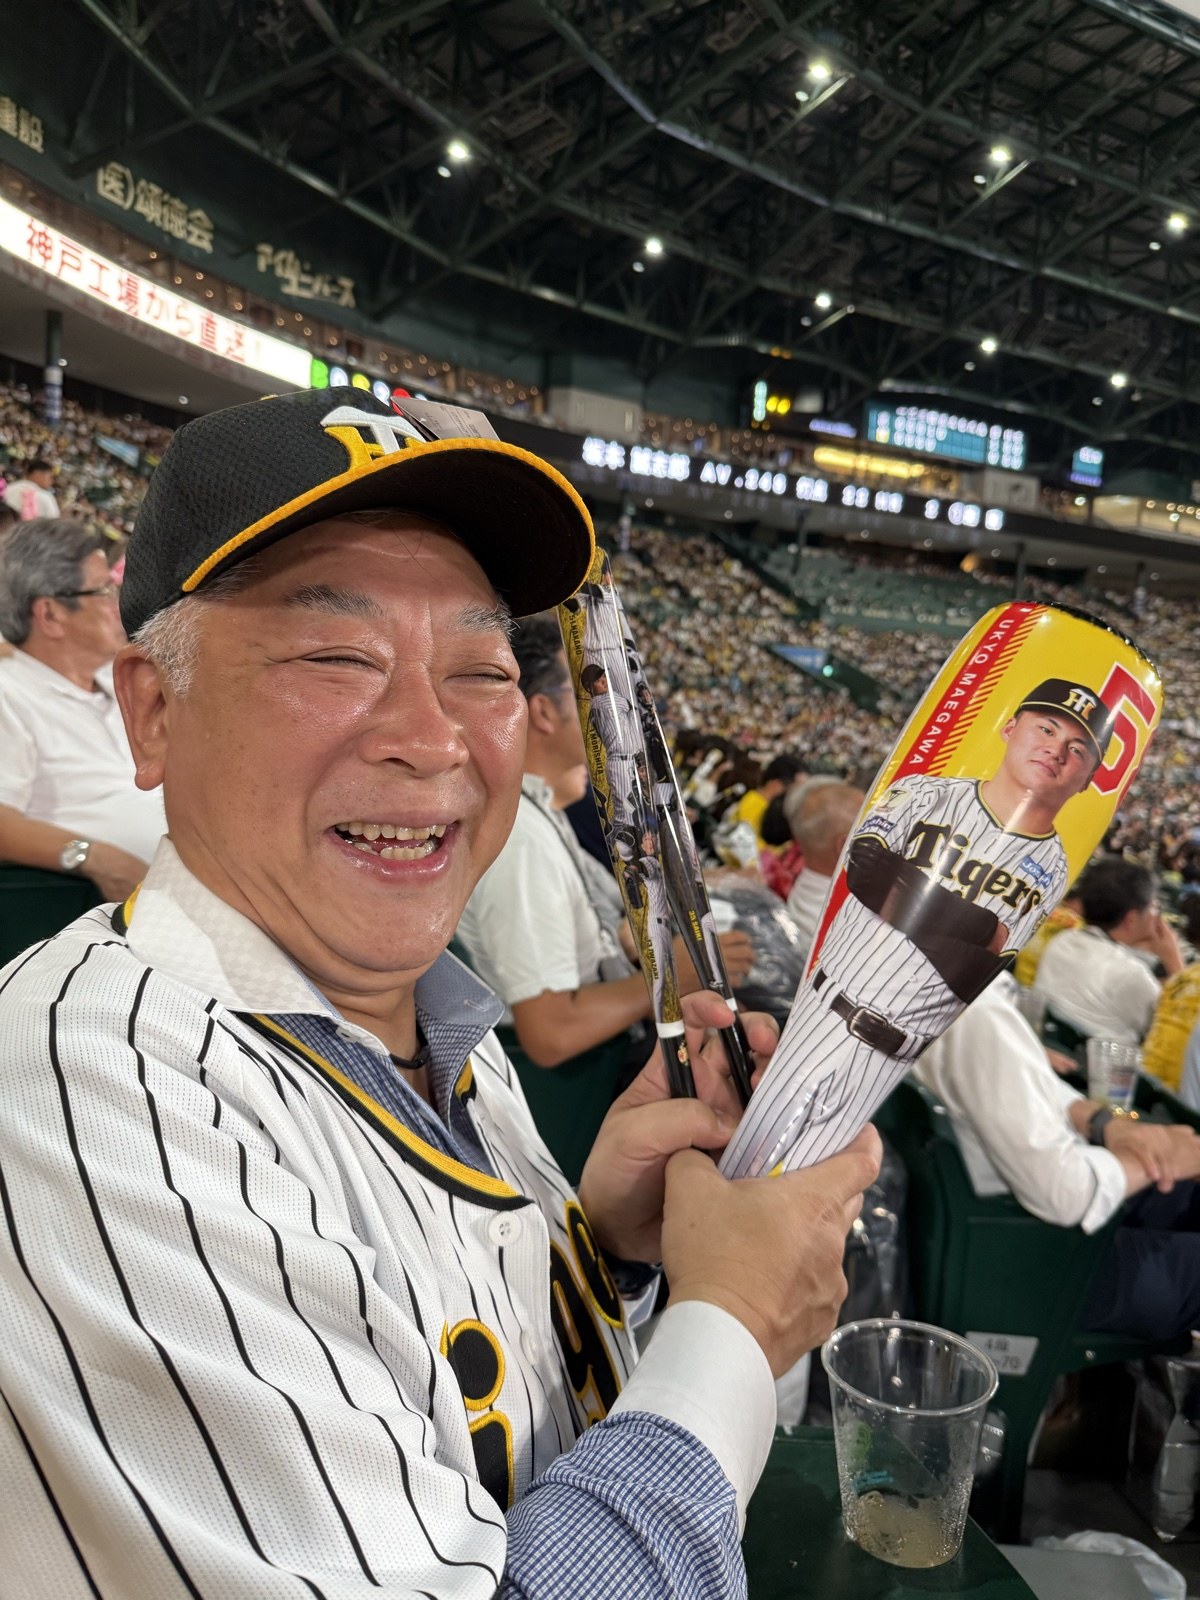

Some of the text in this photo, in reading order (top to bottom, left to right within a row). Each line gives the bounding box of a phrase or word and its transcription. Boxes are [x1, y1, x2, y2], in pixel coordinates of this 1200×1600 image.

[908, 618, 1016, 766] UKYO MAEGAWA
[587, 732, 606, 776] MORISHITA
[903, 819, 1042, 916] Tigers
